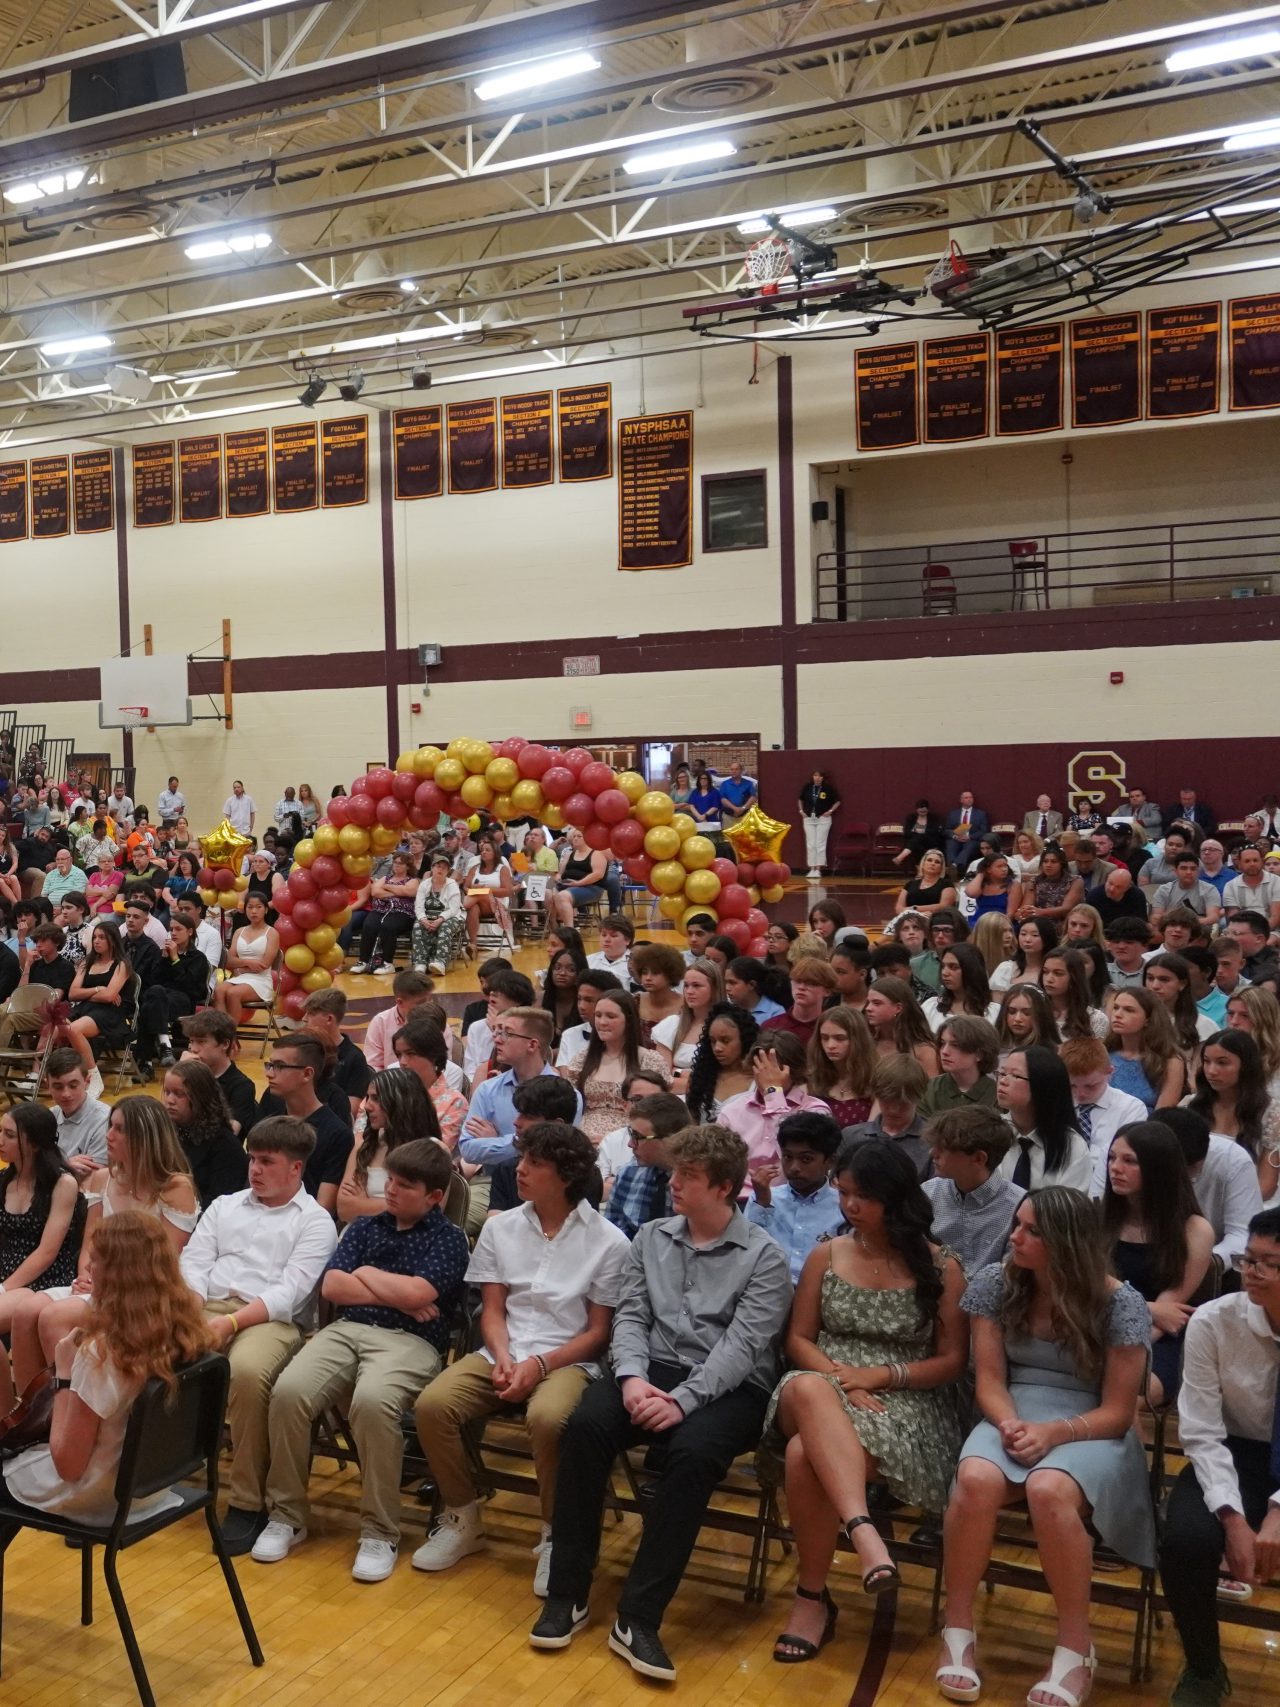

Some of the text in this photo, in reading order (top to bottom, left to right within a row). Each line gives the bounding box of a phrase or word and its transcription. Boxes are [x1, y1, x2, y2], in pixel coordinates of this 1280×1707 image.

[870, 373, 906, 382] CHAMPIONS
[569, 410, 601, 420] CHAMPIONS
[873, 411, 903, 419] FINALIST
[511, 419, 542, 428] CHAMPIONS
[624, 418, 687, 434] NYSPHSAA
[622, 430, 690, 447] STATE CHAMPIONS
[573, 445, 597, 453] FINALIST
[515, 452, 539, 460] FINALIST
